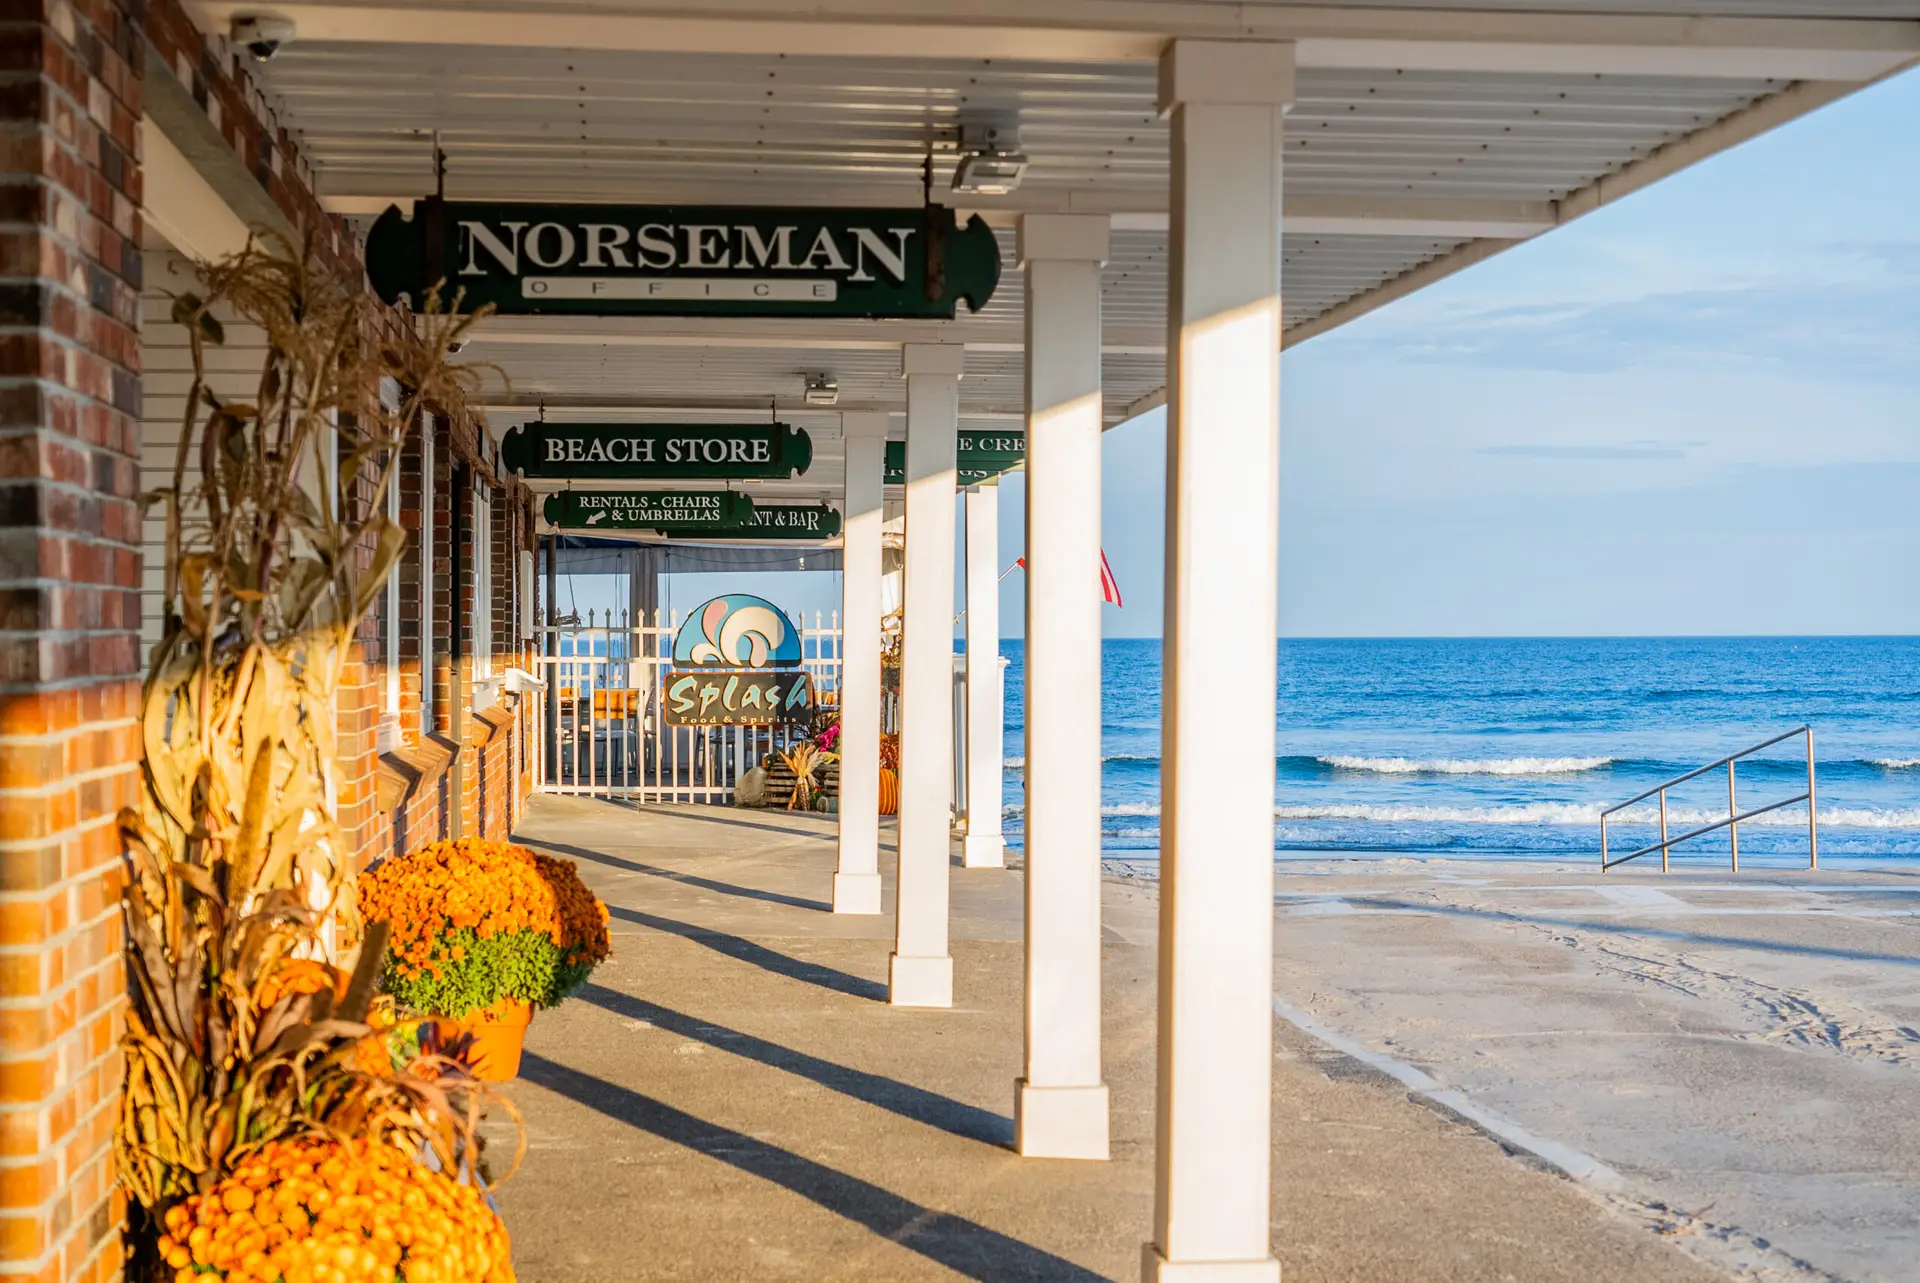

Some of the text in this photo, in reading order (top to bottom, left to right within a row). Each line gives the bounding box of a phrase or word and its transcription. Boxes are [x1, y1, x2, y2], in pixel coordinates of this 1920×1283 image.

[457, 221, 916, 283] NORSEMAN
[530, 281, 826, 297] OFFICE
[545, 438, 771, 463] BEACH STORE
[579, 496, 648, 508] RENTALS
[661, 496, 720, 508] CHAIRS
[611, 509, 720, 521] & UMBRELLAS
[775, 511, 786, 526] &
[788, 511, 819, 530] BAR
[668, 675, 807, 716] Splash
[723, 715, 733, 723] &
[740, 715, 797, 723] Spirits
